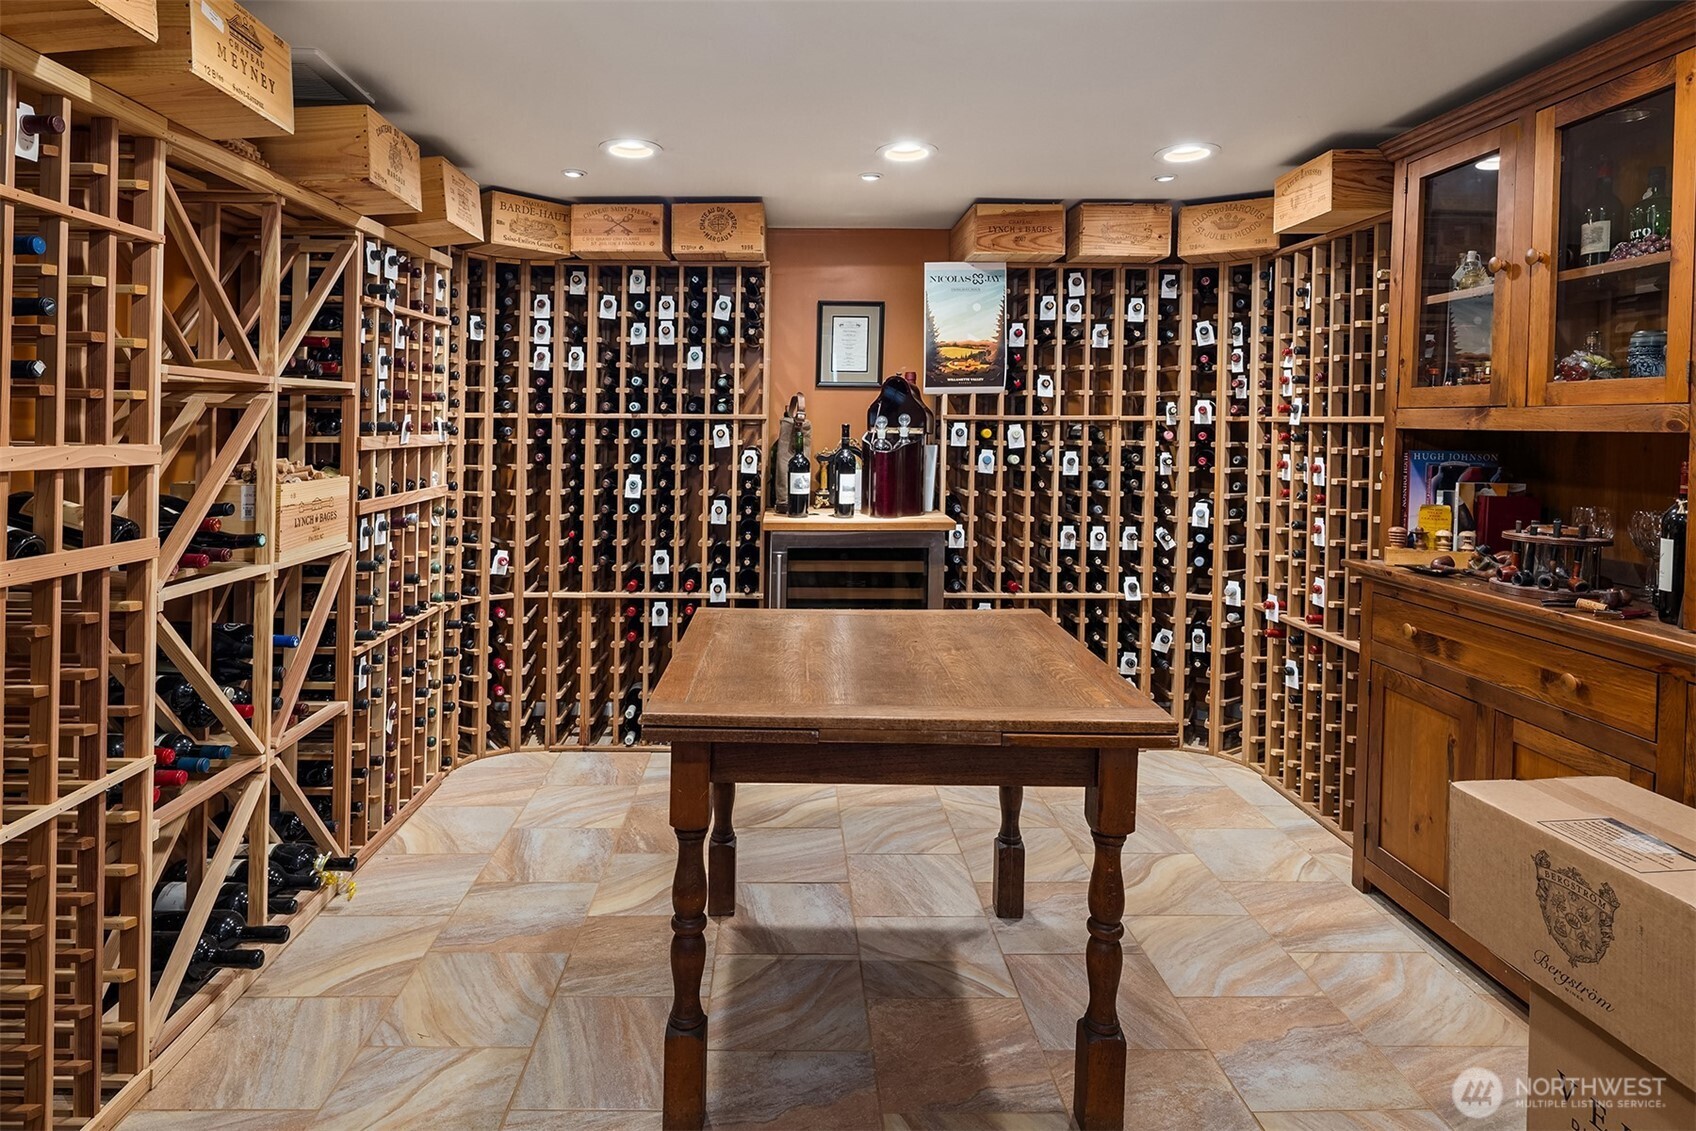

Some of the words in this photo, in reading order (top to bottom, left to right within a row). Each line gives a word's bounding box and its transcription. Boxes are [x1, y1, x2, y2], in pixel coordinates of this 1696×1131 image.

[229, 39, 265, 69] CHATEAU
[217, 42, 275, 94] MEYNEY
[500, 201, 569, 222] BARDE-HAUT
[1191, 208, 1215, 227] CLOS
[1225, 203, 1265, 220] MARQUIS
[1204, 231, 1232, 240] JULIEN
[985, 275, 1001, 283] JAY
[1413, 452, 1445, 461] HUGH
[1449, 452, 1498, 462] JOHNSON
[294, 515, 314, 528] LYNCH
[319, 511, 338, 523] BAGES
[1533, 949, 1615, 1013] Bergström
